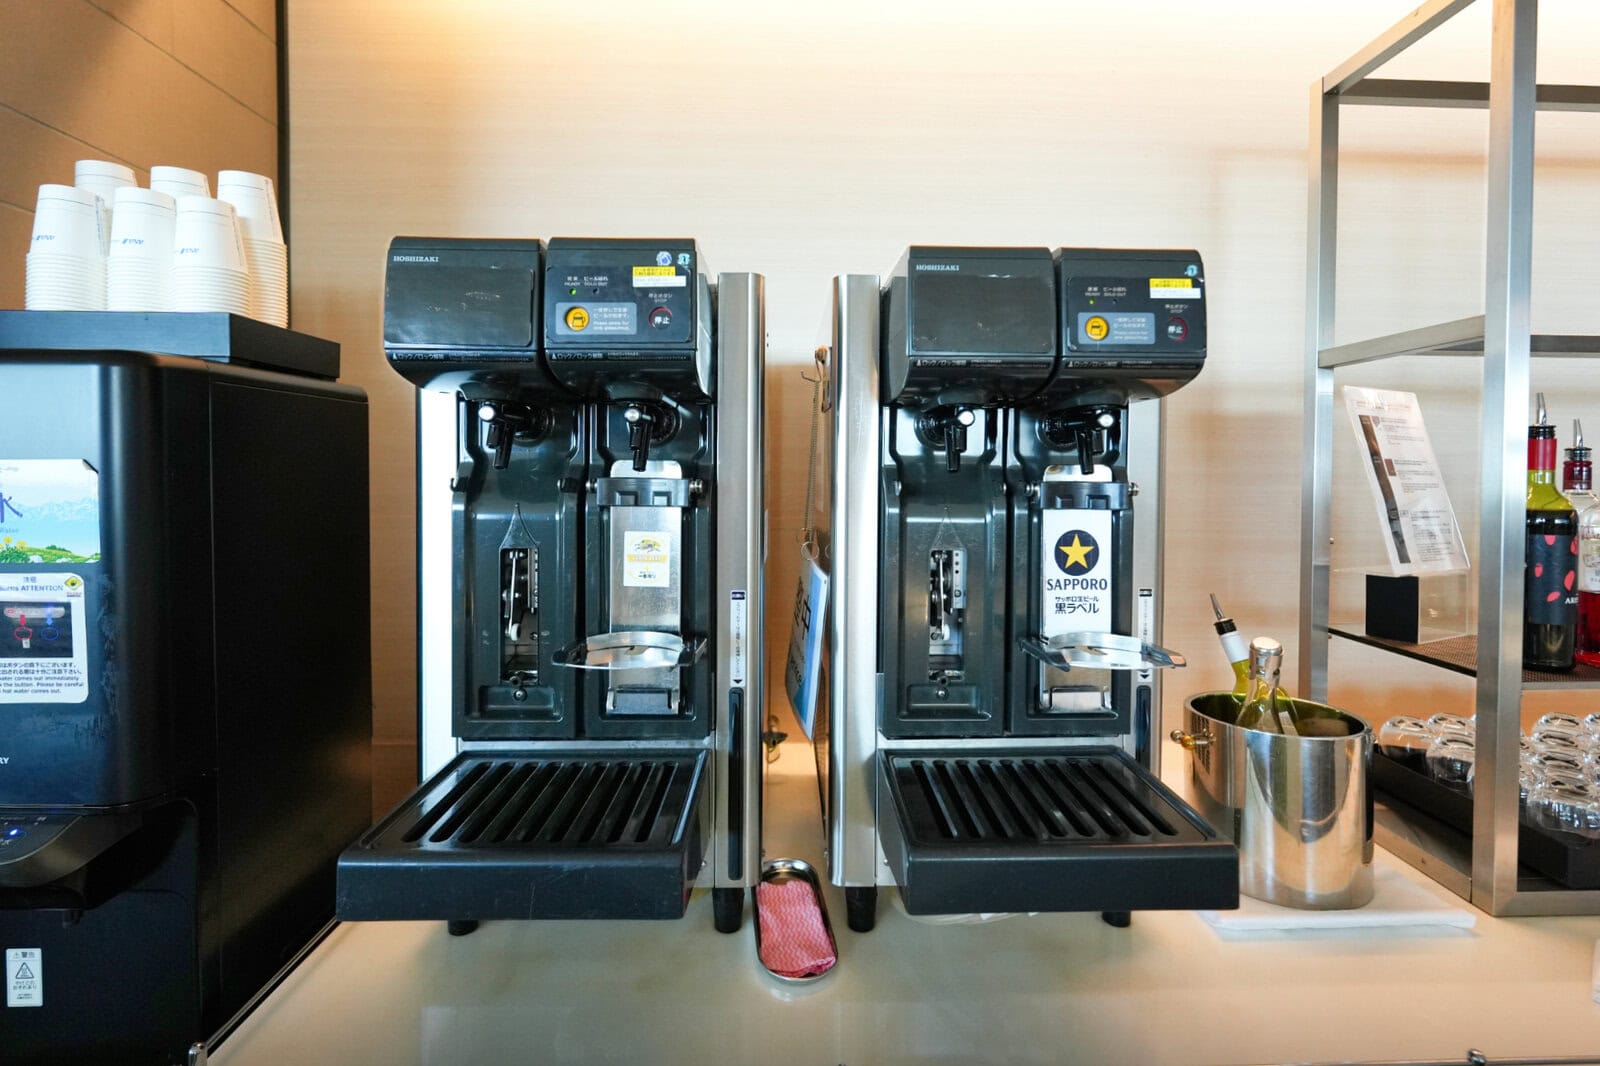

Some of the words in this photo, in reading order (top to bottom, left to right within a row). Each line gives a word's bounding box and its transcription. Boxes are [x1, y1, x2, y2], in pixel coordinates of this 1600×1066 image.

[654, 315, 670, 324] 停止
[1167, 325, 1183, 334] 停止
[1047, 578, 1108, 591] SAPPORO
[1055, 602, 1100, 614] 黒ラベル
